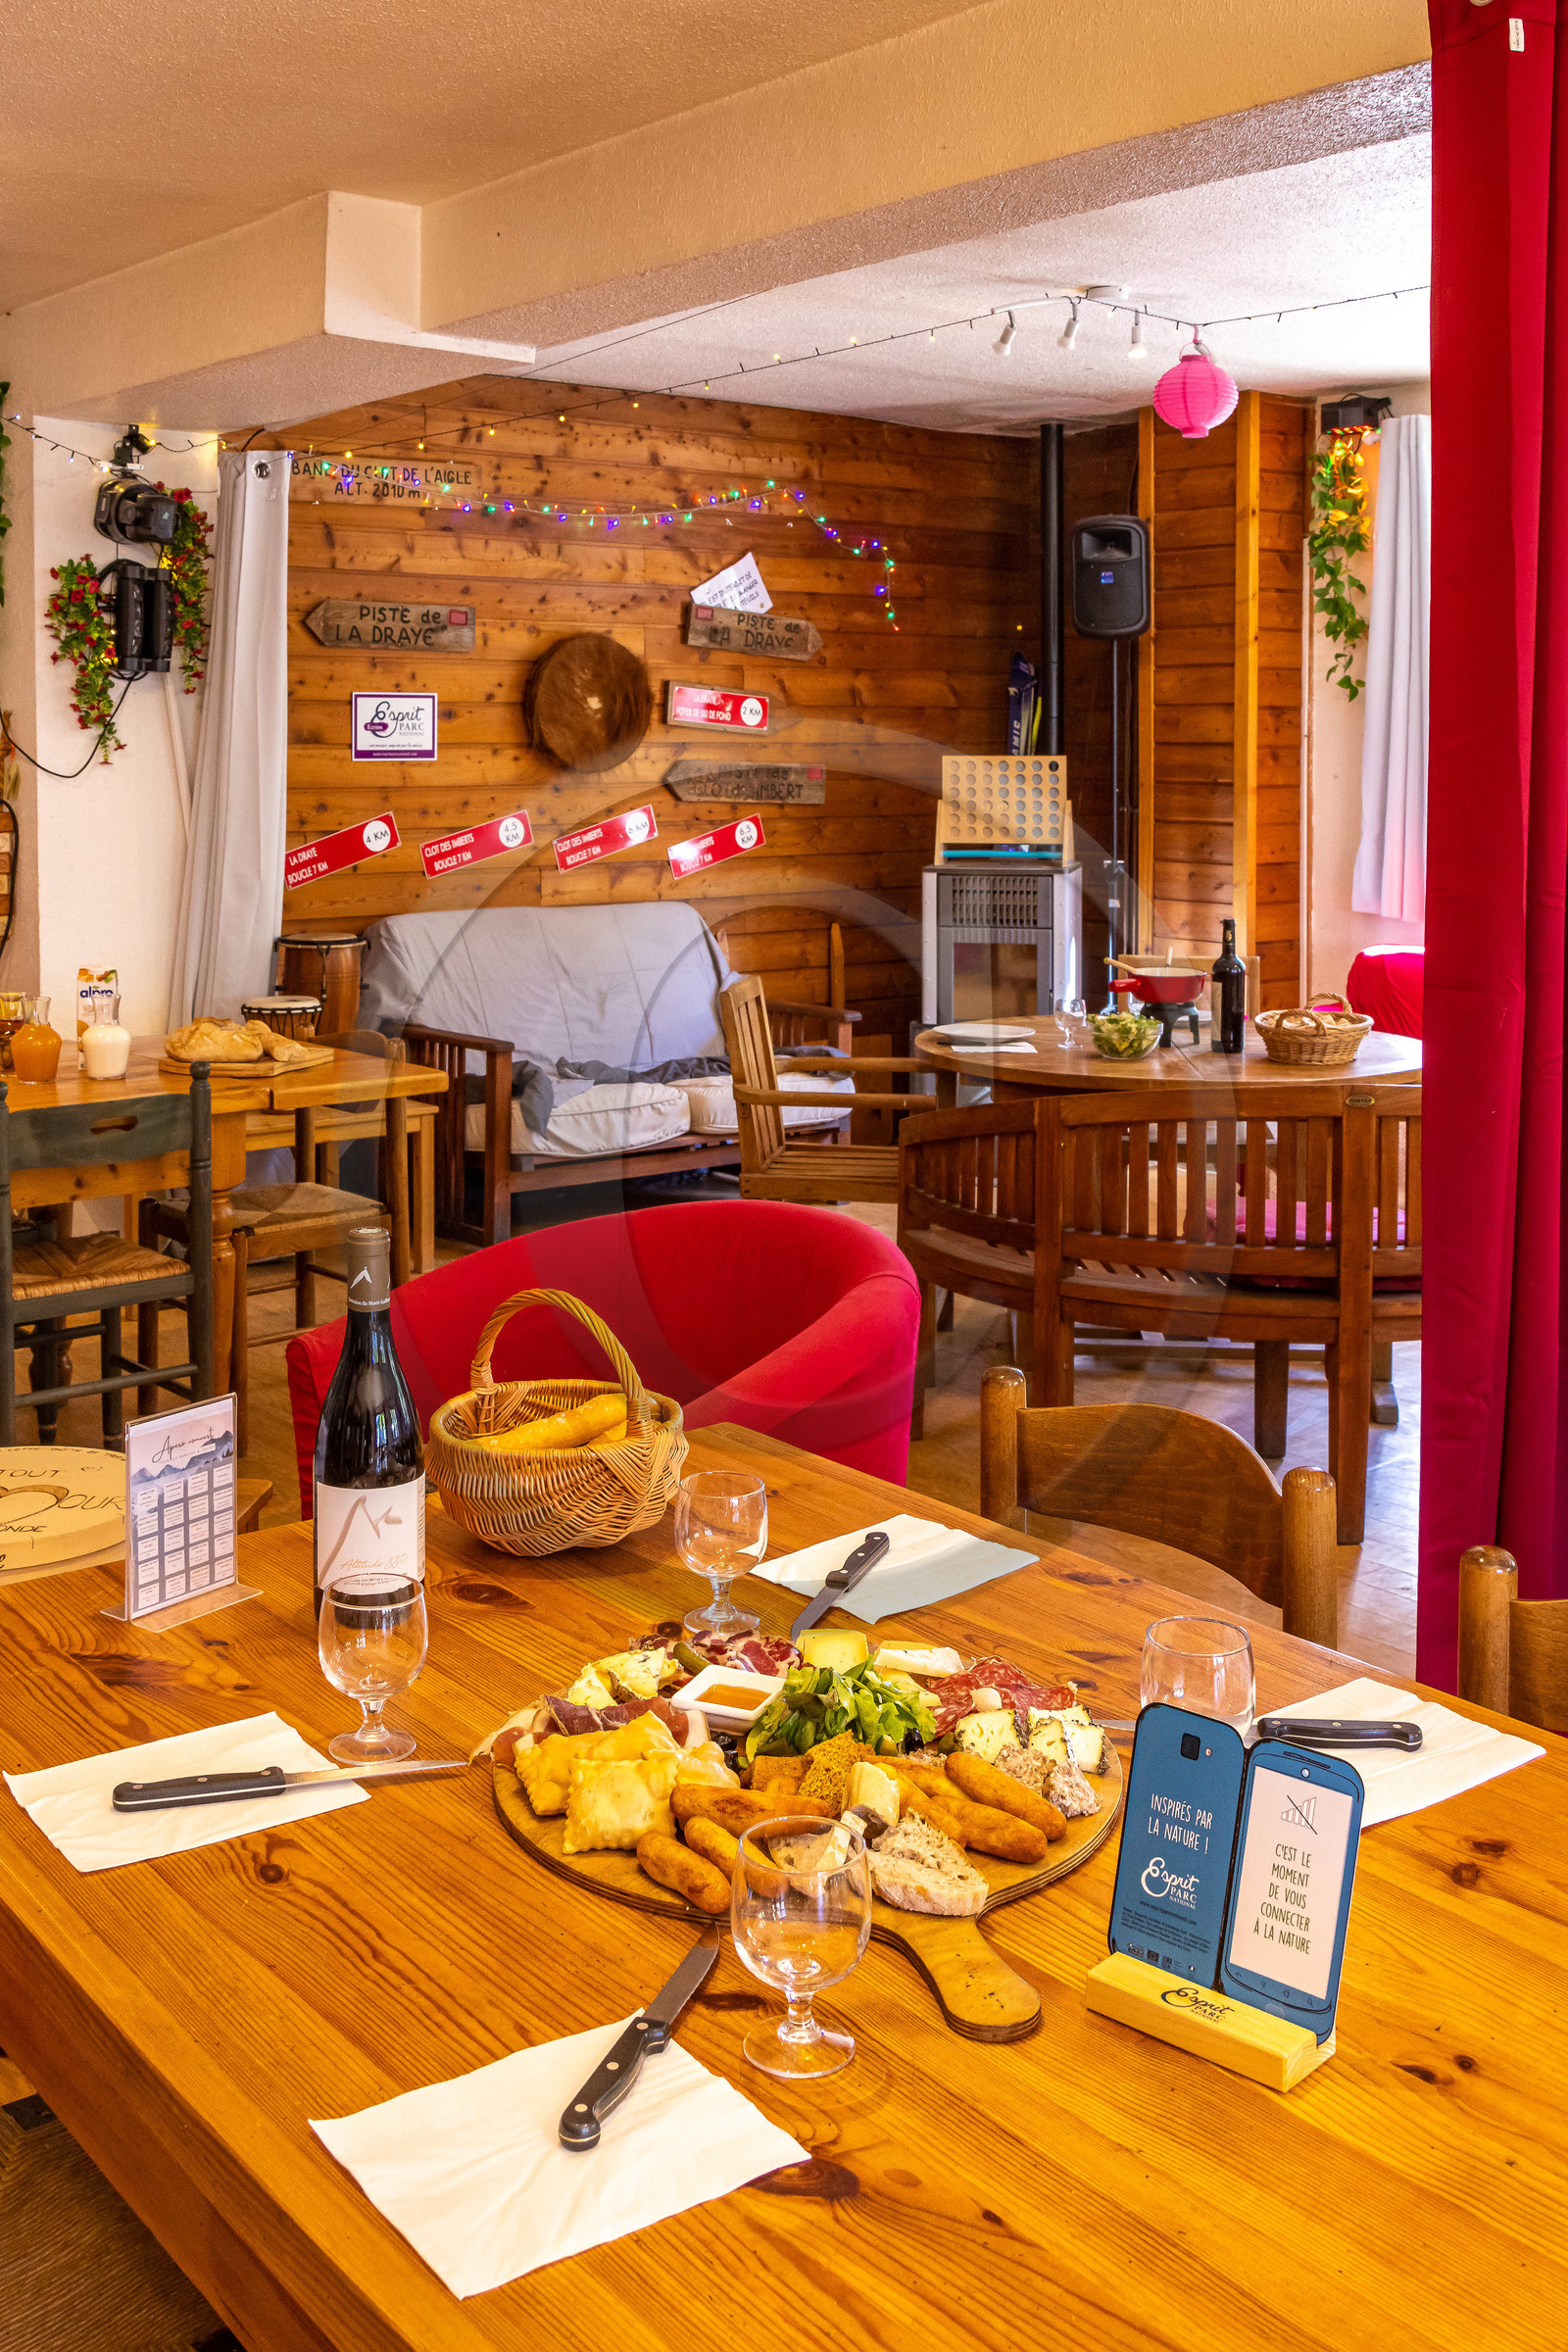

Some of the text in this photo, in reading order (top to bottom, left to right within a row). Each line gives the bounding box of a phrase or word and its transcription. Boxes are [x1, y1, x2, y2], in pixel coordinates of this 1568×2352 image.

[342, 464, 360, 478] DU
[403, 467, 418, 481] DE
[424, 466, 472, 485] L'AIGLE
[372, 483, 405, 498] 2010
[408, 490, 420, 499] m
[360, 605, 441, 624] PISTE de
[737, 612, 801, 634] PISTE de
[335, 624, 434, 646] LA DRAYE
[370, 701, 424, 738] Esprit
[709, 710, 715, 719] DE
[716, 710, 731, 721] FOND
[749, 708, 761, 716] KM
[399, 722, 424, 731] PARC
[373, 829, 390, 841] KM
[506, 833, 519, 843] KM
[557, 828, 603, 853] CLOT DES IMBERTS
[741, 835, 754, 845] KM
[424, 833, 474, 858] CLOT DES IMBERTS
[565, 851, 588, 865] BOUCLE
[592, 845, 602, 856] KM
[288, 847, 318, 865] LA DRAYE
[433, 856, 458, 871] BOUCLE
[462, 851, 472, 861] KM
[704, 853, 713, 862] KM
[287, 861, 328, 885] BOUCLE 7 KM
[340, 1558, 382, 1572] Altitude
[1151, 1793, 1213, 1830] INSPIRÉS PAR
[1148, 1816, 1159, 1837] LA
[1164, 1824, 1200, 1851] NATURE
[1275, 1843, 1311, 1868] C'EST LE
[1141, 1857, 1200, 1897] Esprit
[1271, 1863, 1310, 1887] MOMENT
[1169, 1895, 1197, 1910] NATIONAL
[1170, 1886, 1198, 1904] PARC
[1268, 1883, 1307, 1910] DE VOUS
[1260, 1902, 1310, 1932] CONNECTER
[1253, 1918, 1311, 1955] À LA NATURE
[1160, 1987, 1235, 2015] Esprit
[1194, 2005, 1225, 2020] PARC
